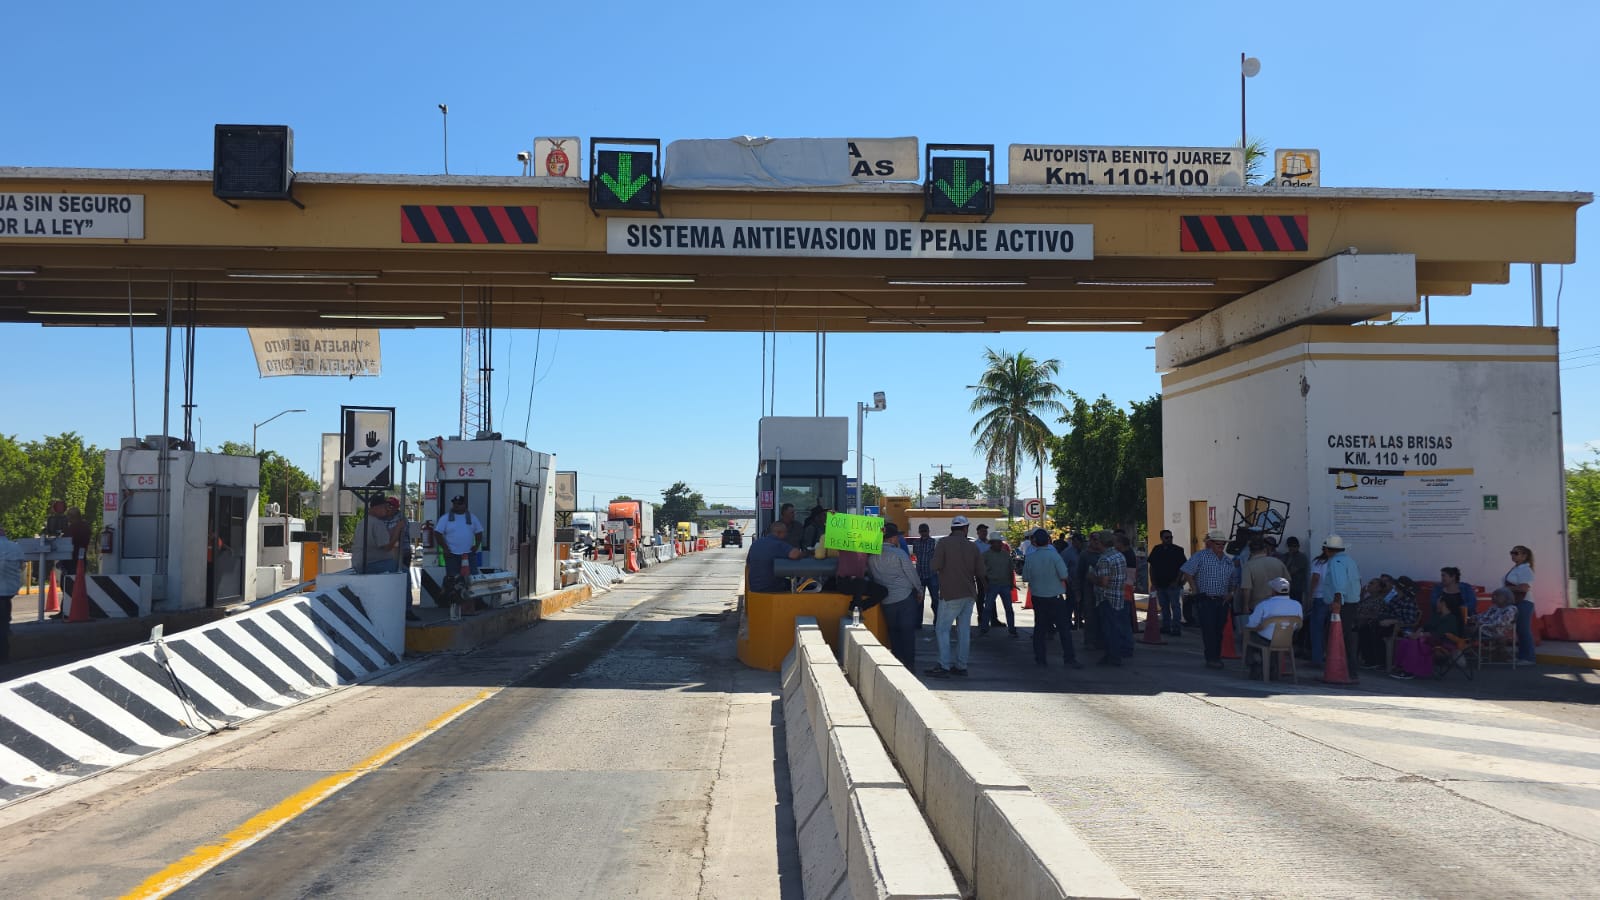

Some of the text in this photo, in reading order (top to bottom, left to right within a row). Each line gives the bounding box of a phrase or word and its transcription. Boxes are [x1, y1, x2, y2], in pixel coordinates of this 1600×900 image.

[1023, 148, 1231, 165] AUTOPISTA BENITO JUAREZ
[1046, 167, 1209, 186] Km. 110+100
[23, 195, 53, 212] SIN
[58, 196, 132, 213] SEGURO
[24, 218, 46, 235] LA
[627, 224, 1074, 253] SISTEMA ANTIEVASION DE PEAJE ACTIVO
[1328, 434, 1453, 449] CASETA LAS BRISAS
[1344, 451, 1437, 466] KM. 110 + 100
[458, 467, 475, 477] C-2
[1361, 476, 1388, 486] Orler
[1030, 503, 1040, 515] E
